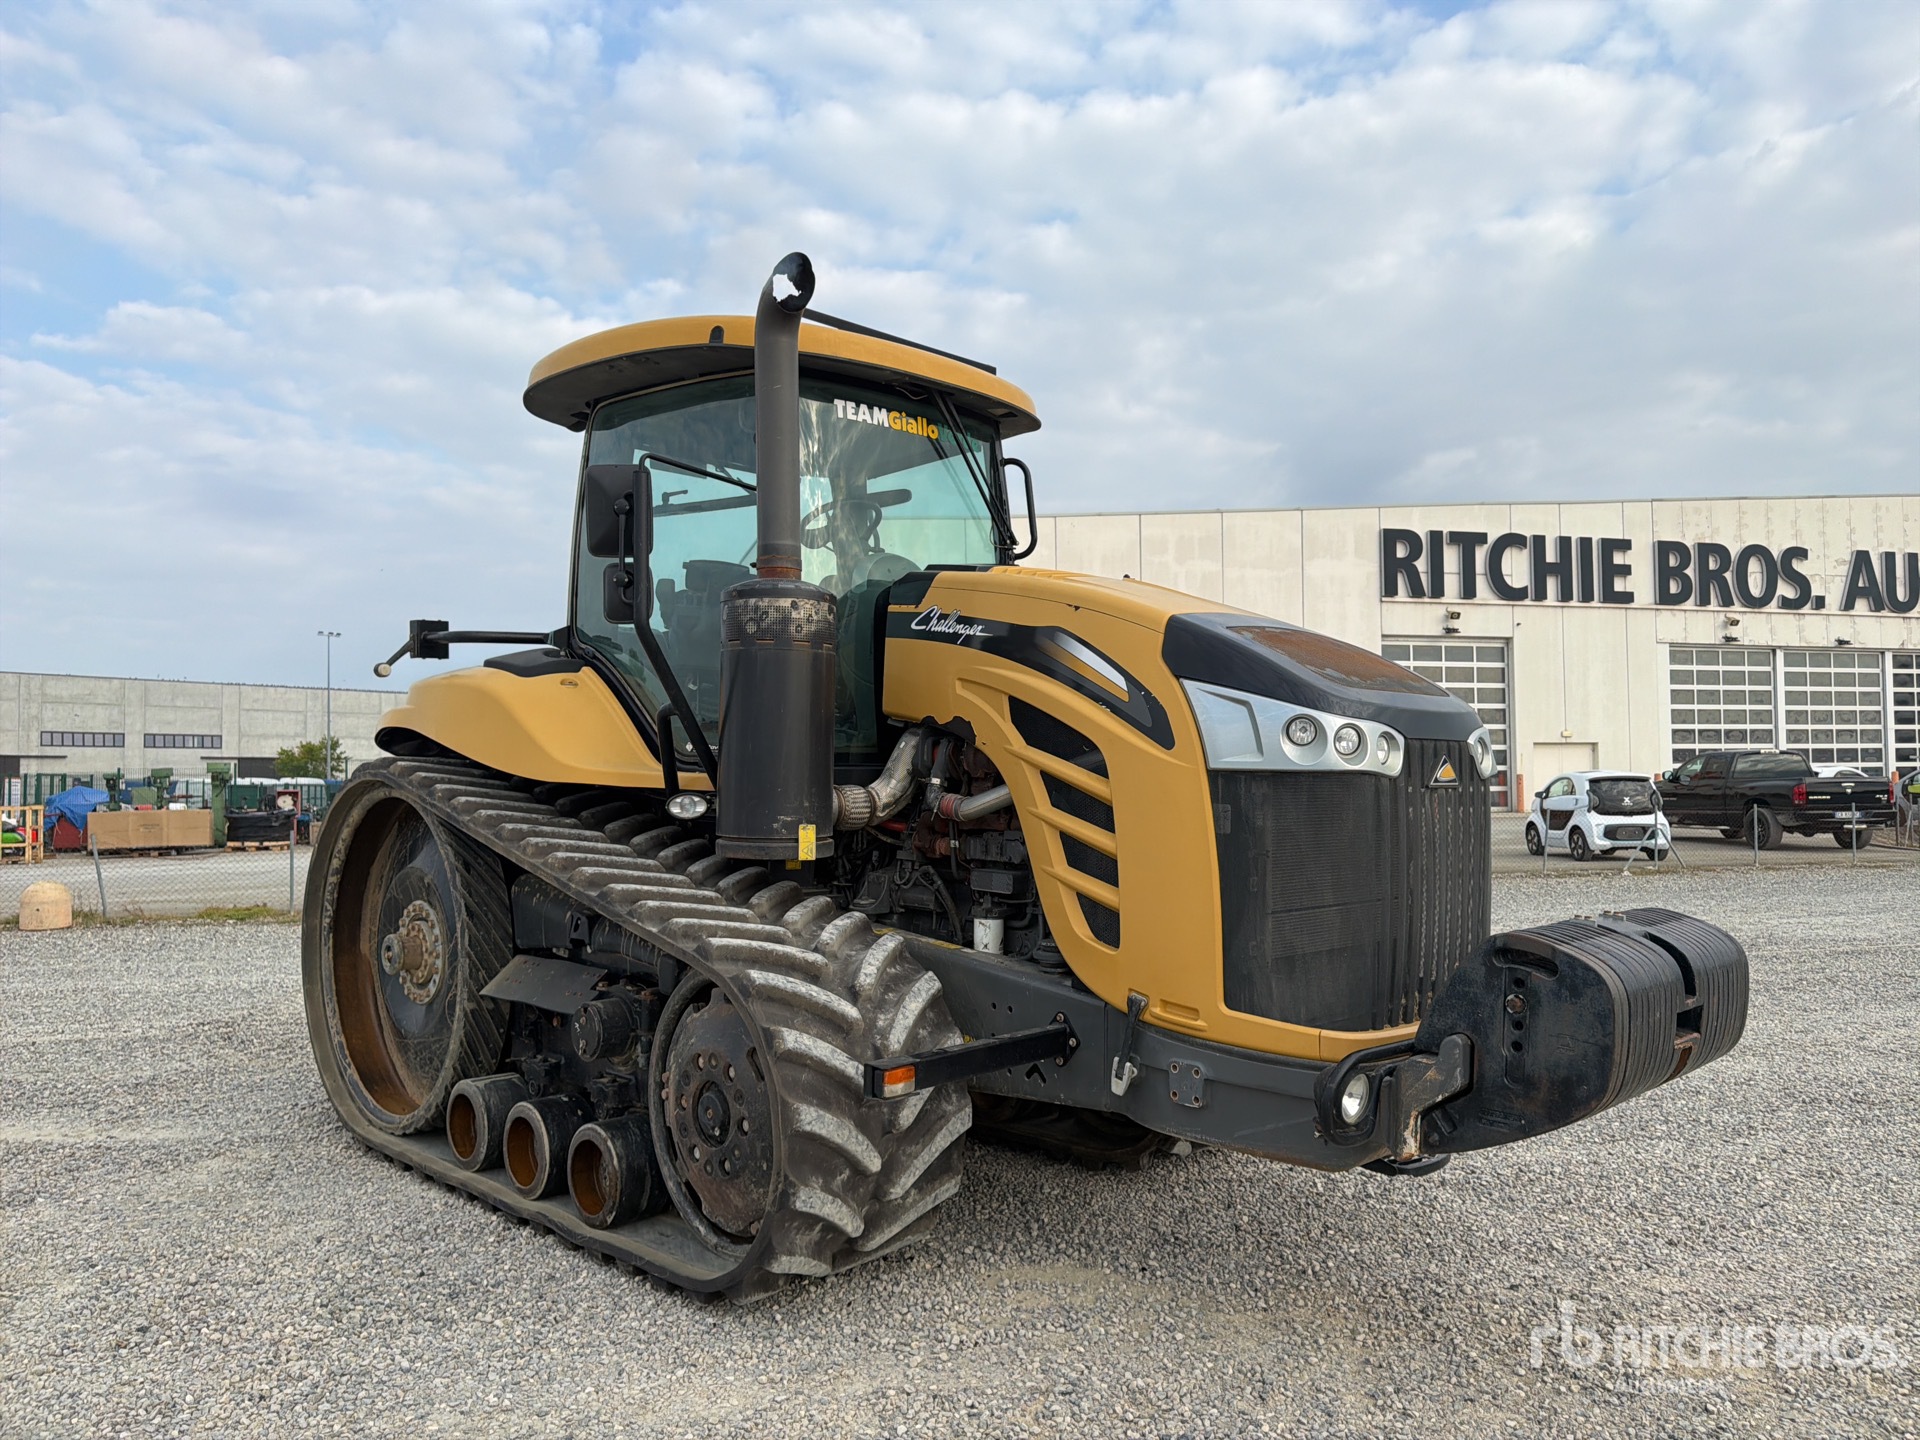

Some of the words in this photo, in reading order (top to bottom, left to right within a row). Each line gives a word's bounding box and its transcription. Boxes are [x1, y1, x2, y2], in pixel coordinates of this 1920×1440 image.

[1381, 528, 1635, 604] RITCHIE
[1654, 540, 1826, 610] BROS.
[1840, 549, 1920, 614] AU
[910, 605, 993, 645] Challenger
